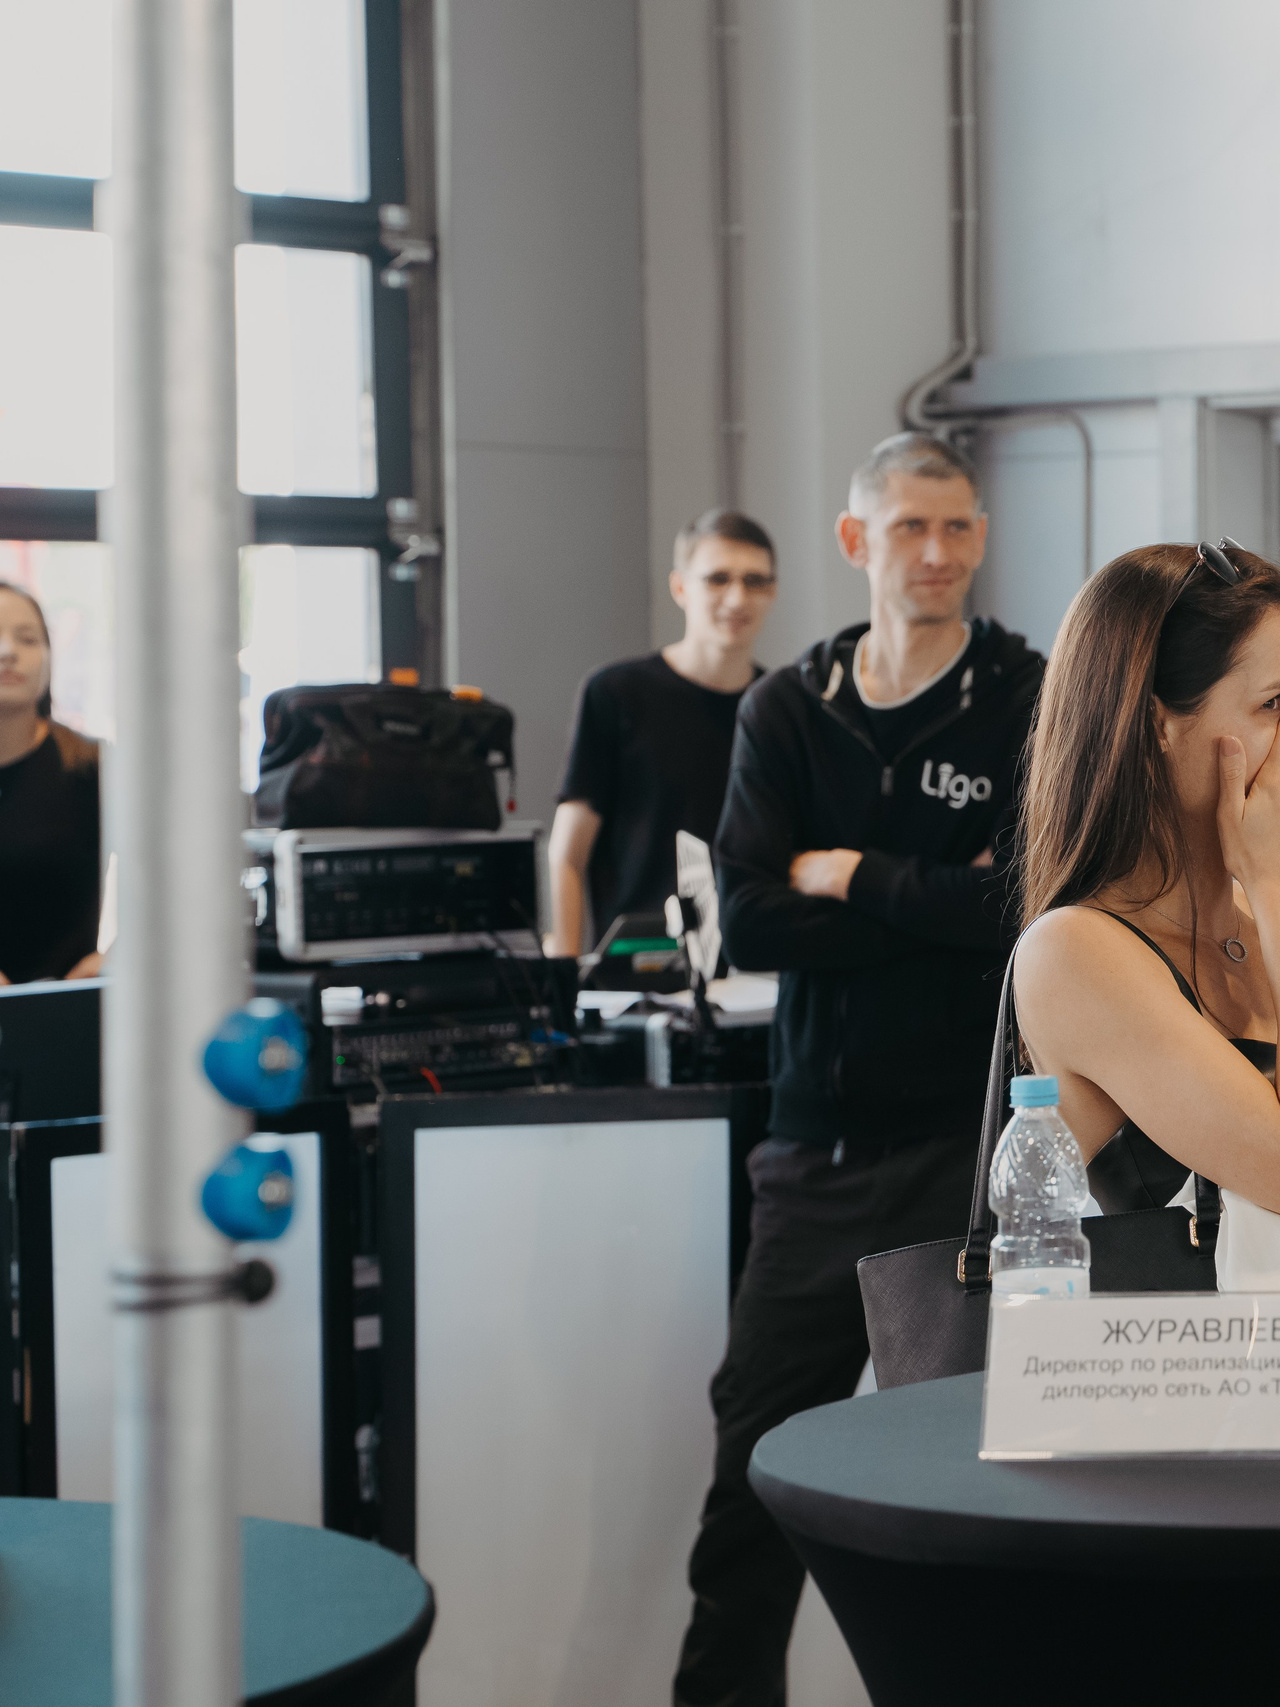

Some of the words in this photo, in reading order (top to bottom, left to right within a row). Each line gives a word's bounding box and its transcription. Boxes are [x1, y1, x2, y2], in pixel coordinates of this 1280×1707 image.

[1023, 1355, 1124, 1376] Директор
[1130, 1357, 1156, 1372] по
[1042, 1382, 1158, 1401] дилерскую
[1165, 1380, 1211, 1397] сеть
[1218, 1376, 1251, 1397] АО
